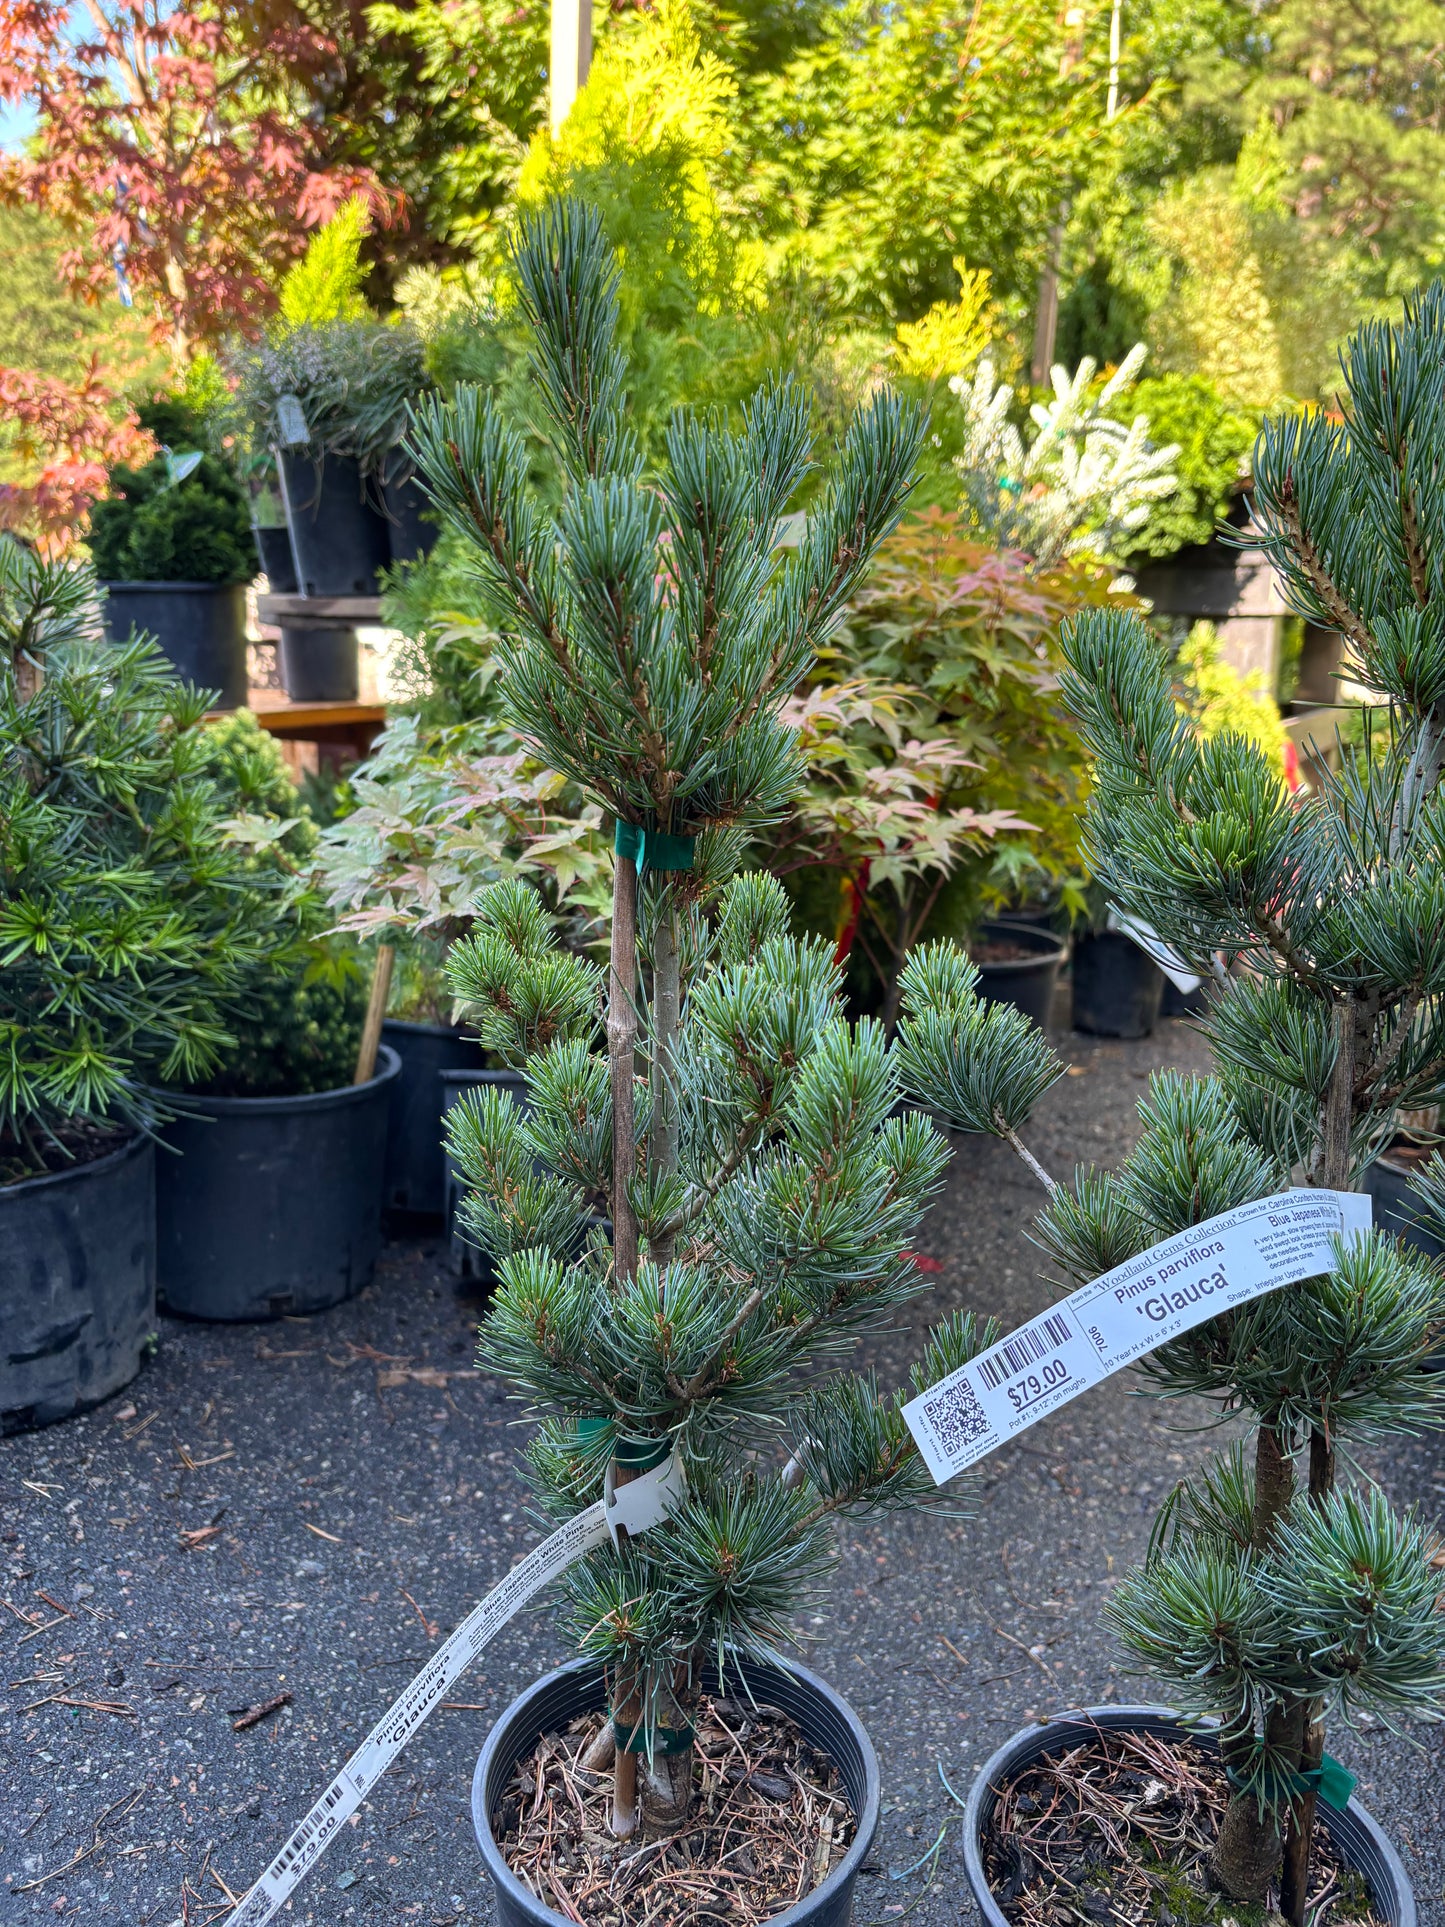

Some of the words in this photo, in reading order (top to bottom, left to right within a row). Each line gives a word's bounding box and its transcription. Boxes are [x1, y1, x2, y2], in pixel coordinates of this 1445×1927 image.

[1259, 1234, 1273, 1244] very
[1287, 1227, 1299, 1235] slow
[1267, 1214, 1291, 1228] Blue
[1290, 1206, 1322, 1223] Japanese
[1093, 1255, 1152, 1291] "Woodland
[1152, 1241, 1184, 1263] Gems
[1184, 1214, 1237, 1247] Collection"
[1238, 1207, 1259, 1219] Grown
[1257, 1204, 1267, 1212] for
[1267, 1196, 1295, 1210] Carolina
[1258, 1243, 1274, 1254] wind
[1273, 1237, 1291, 1249] swept
[1290, 1235, 1302, 1243] look
[1262, 1253, 1277, 1262] blue
[1269, 1255, 1299, 1270] decorative
[1113, 1275, 1157, 1305] Pinus
[1157, 1241, 1226, 1284] parviflora
[1135, 1262, 1229, 1322] 'Glauca'
[1226, 1287, 1254, 1303] Shape:
[1254, 1274, 1284, 1291] Irregular
[1283, 1266, 1307, 1279] Upright
[1088, 1326, 1109, 1353] 7006
[1113, 1349, 1132, 1363] Year
[1131, 1343, 1140, 1353] H
[1144, 1334, 1155, 1345] W
[924, 1382, 946, 1398] Plant
[949, 1369, 966, 1382] Info
[1007, 1359, 1067, 1409] $79.00
[1008, 1417, 1022, 1430] Pot
[1052, 1392, 1063, 1402] on
[1062, 1377, 1087, 1396] mugho
[929, 1438, 943, 1463] Plant
[483, 1595, 502, 1616] Blue
[503, 1559, 540, 1596] Japanese
[540, 1538, 564, 1559] White
[565, 1524, 585, 1540] Pine
[405, 1673, 427, 1699] Gems
[536, 1533, 560, 1555] Nursery
[566, 1504, 601, 1530] Landscape
[376, 1711, 405, 1747] Pinus
[405, 1655, 450, 1711] parviflora
[387, 1669, 447, 1744] 'Glauca'
[290, 1816, 336, 1874] $79.00
